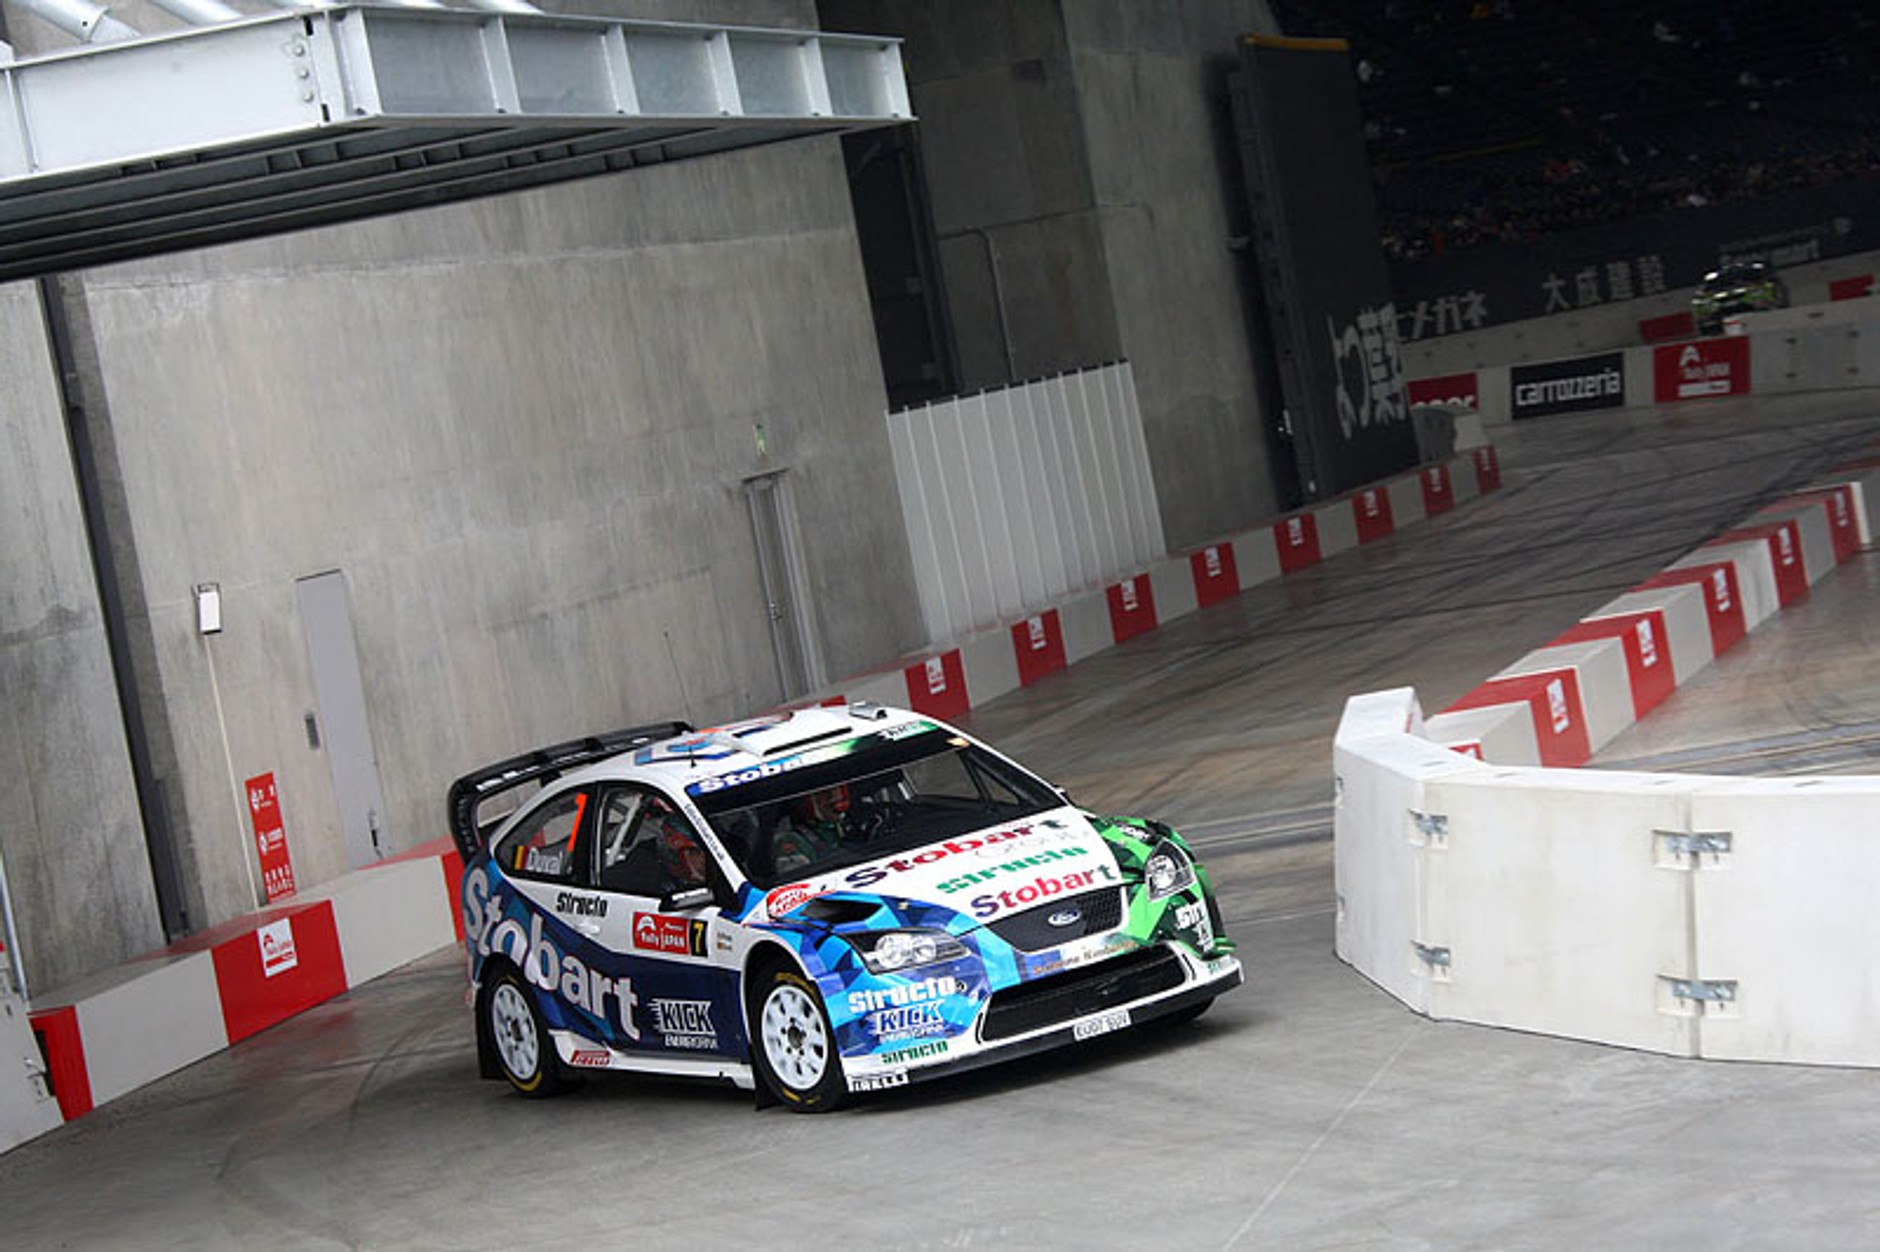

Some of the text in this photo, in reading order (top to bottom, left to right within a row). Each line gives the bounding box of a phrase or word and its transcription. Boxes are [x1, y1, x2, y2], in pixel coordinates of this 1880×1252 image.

[1516, 368, 1621, 406] carrozzeria
[526, 846, 563, 876] Duval
[844, 819, 1069, 890] Stobart
[970, 864, 1117, 918] Stobart
[462, 866, 640, 1040] Stobart
[693, 921, 705, 954] 7
[661, 1001, 712, 1032] KICK
